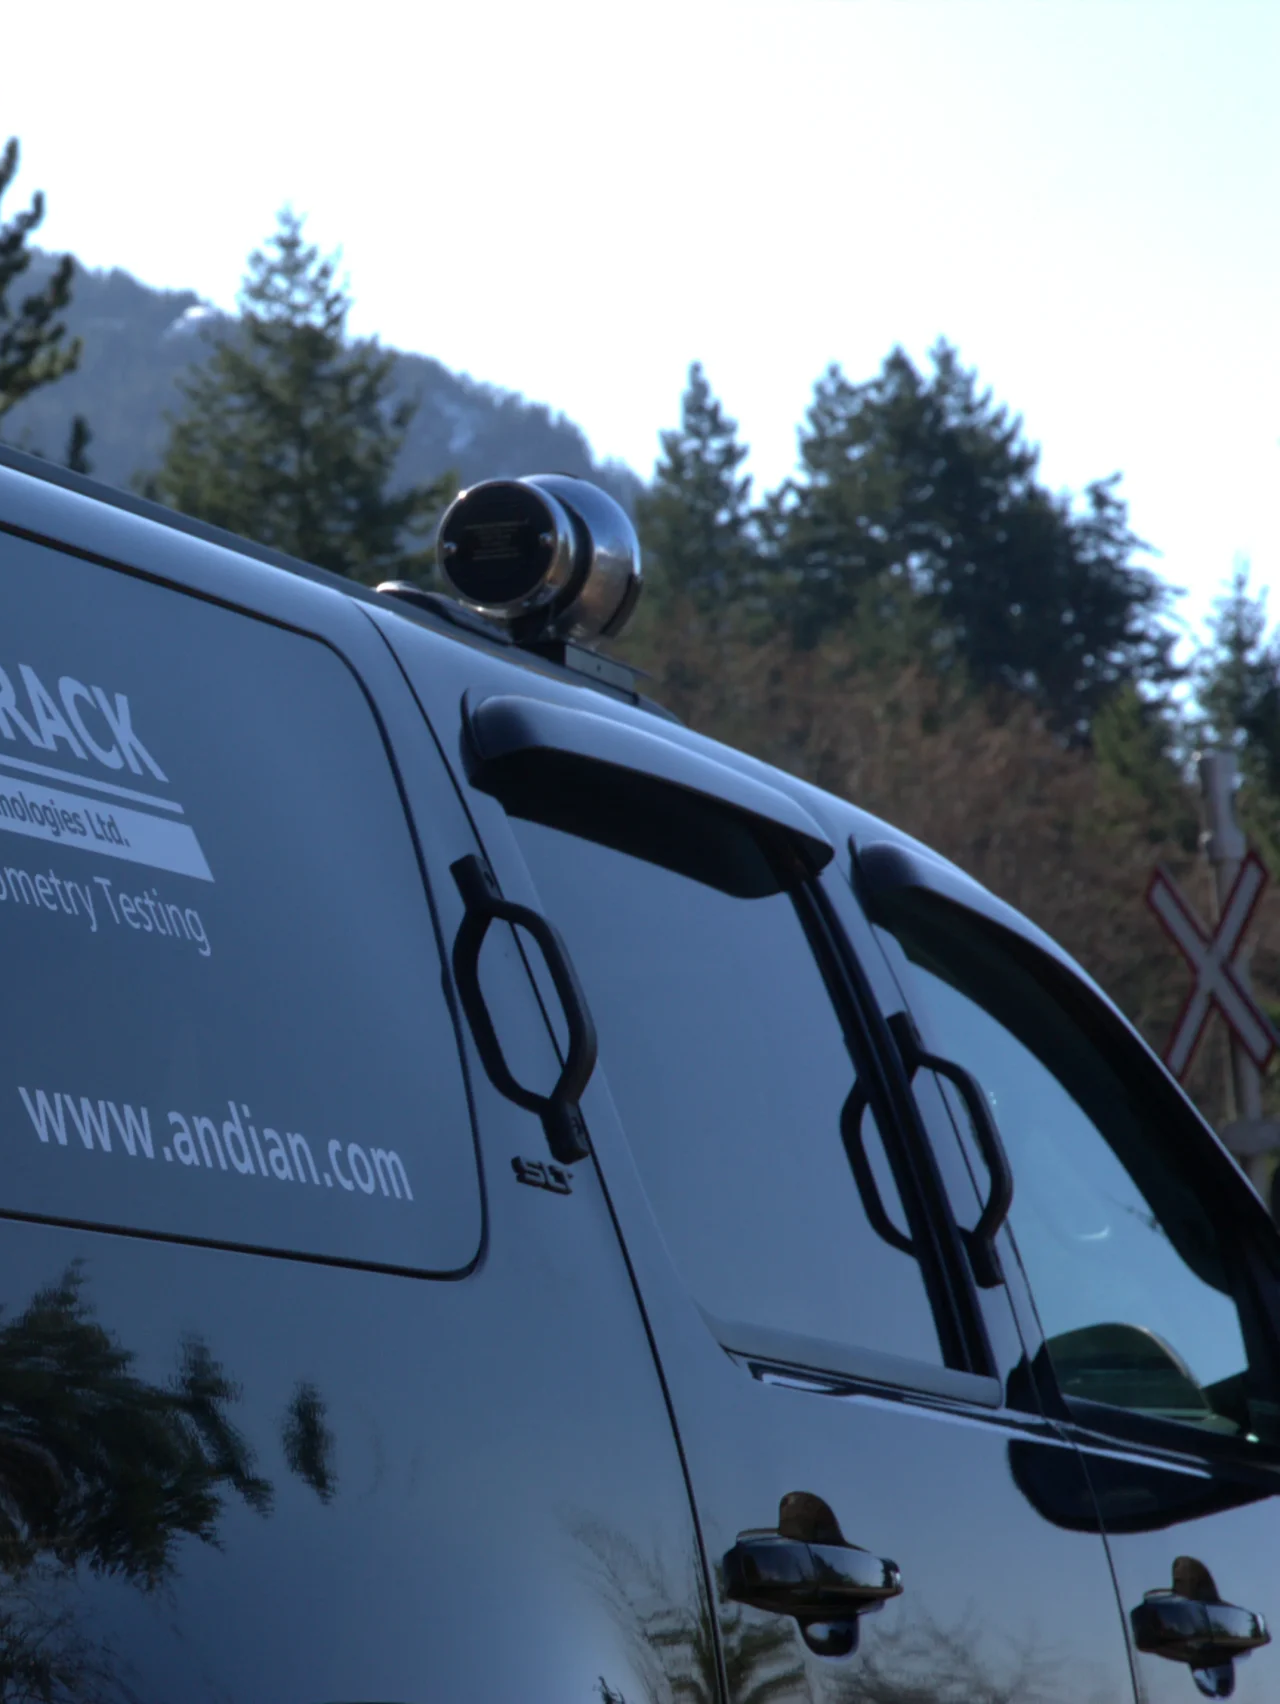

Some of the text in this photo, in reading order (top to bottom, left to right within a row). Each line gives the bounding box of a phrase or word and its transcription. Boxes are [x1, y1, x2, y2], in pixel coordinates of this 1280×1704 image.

[83, 809, 131, 847] Ltd.
[94, 876, 211, 957] Testing
[18, 1085, 414, 1202] www.andian.com
